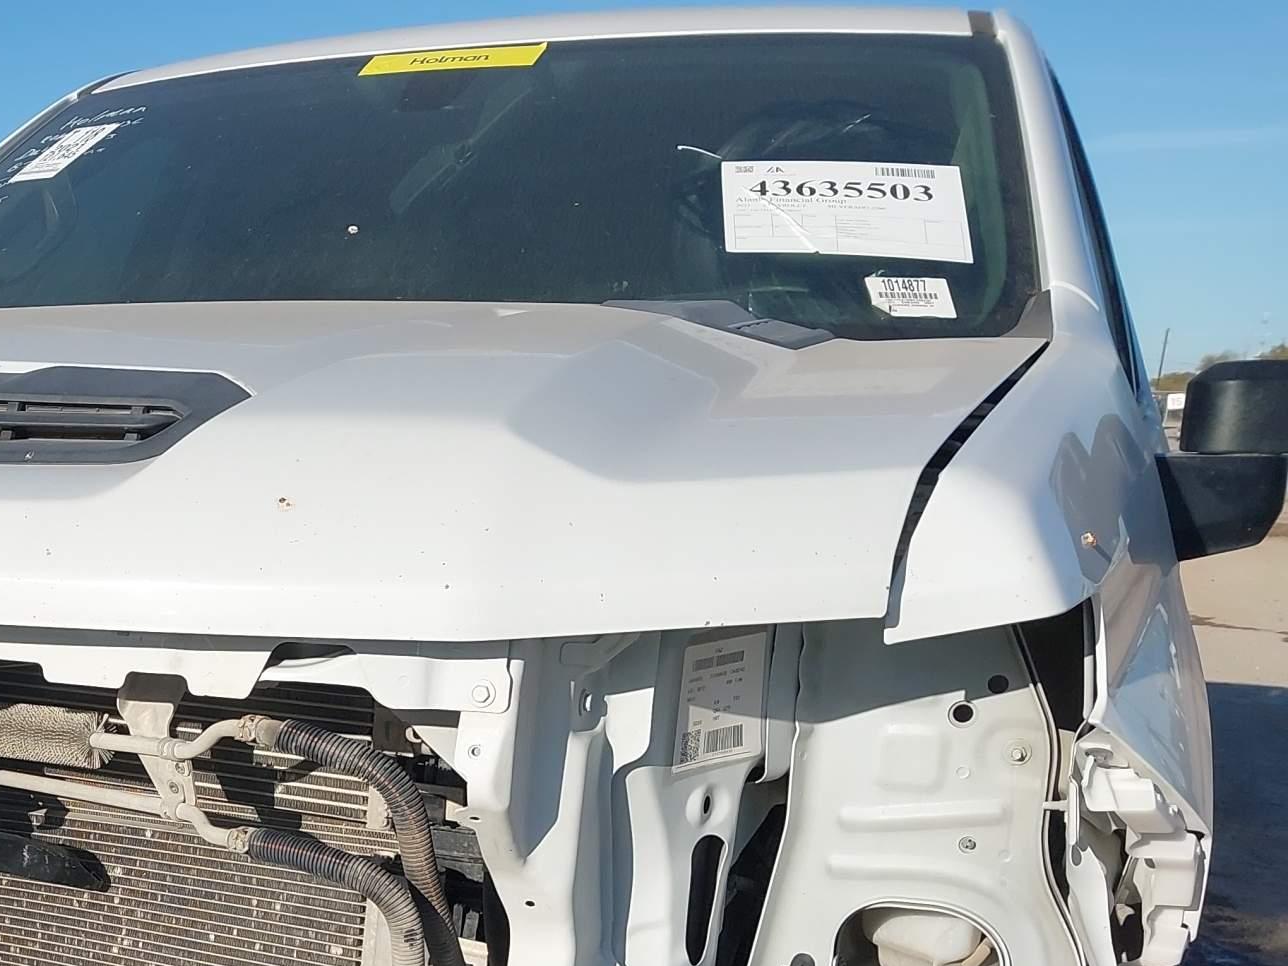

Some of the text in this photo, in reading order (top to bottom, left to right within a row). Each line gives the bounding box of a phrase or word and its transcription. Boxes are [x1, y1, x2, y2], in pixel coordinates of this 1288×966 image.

[409, 53, 490, 66] Holman
[748, 179, 934, 202] 43635503
[881, 278, 926, 292] 1014877
